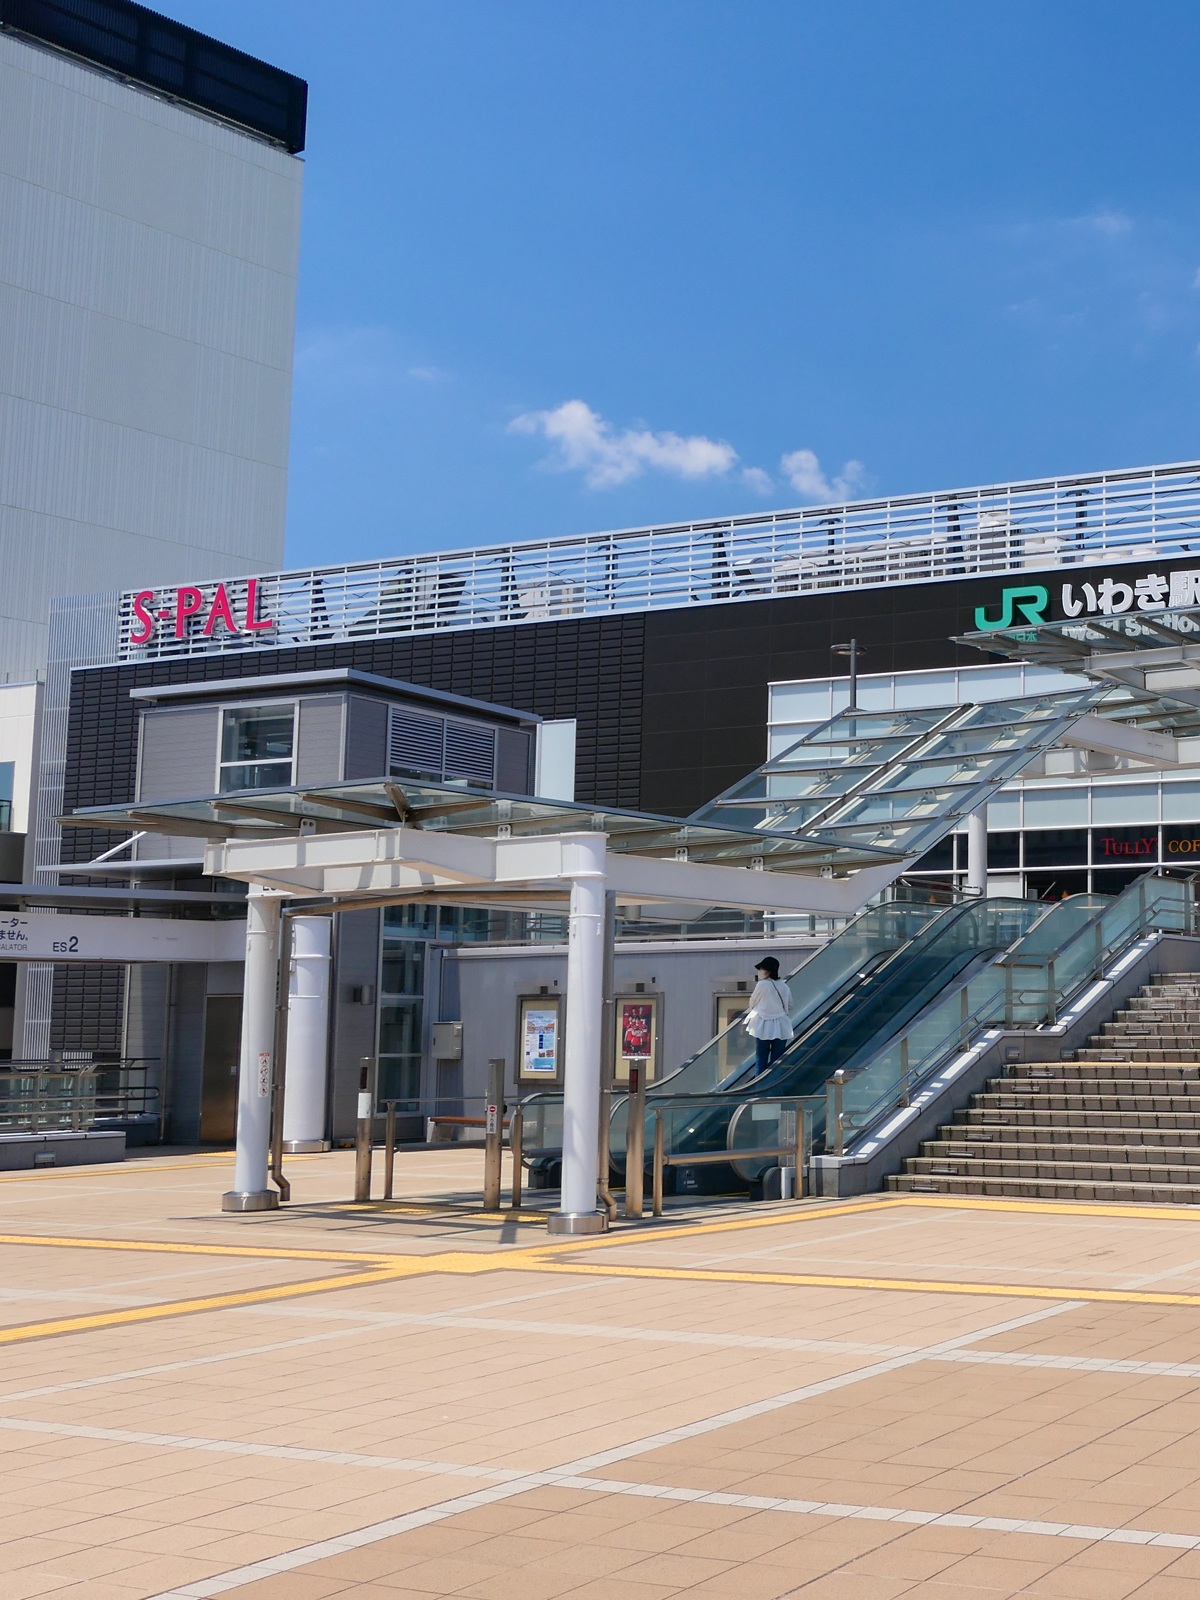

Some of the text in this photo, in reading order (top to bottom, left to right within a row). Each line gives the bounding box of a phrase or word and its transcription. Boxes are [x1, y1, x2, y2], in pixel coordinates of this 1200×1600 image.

[130, 578, 273, 644] S-PAL
[974, 585, 1049, 631] JR
[0, 943, 28, 951] ALATOR
